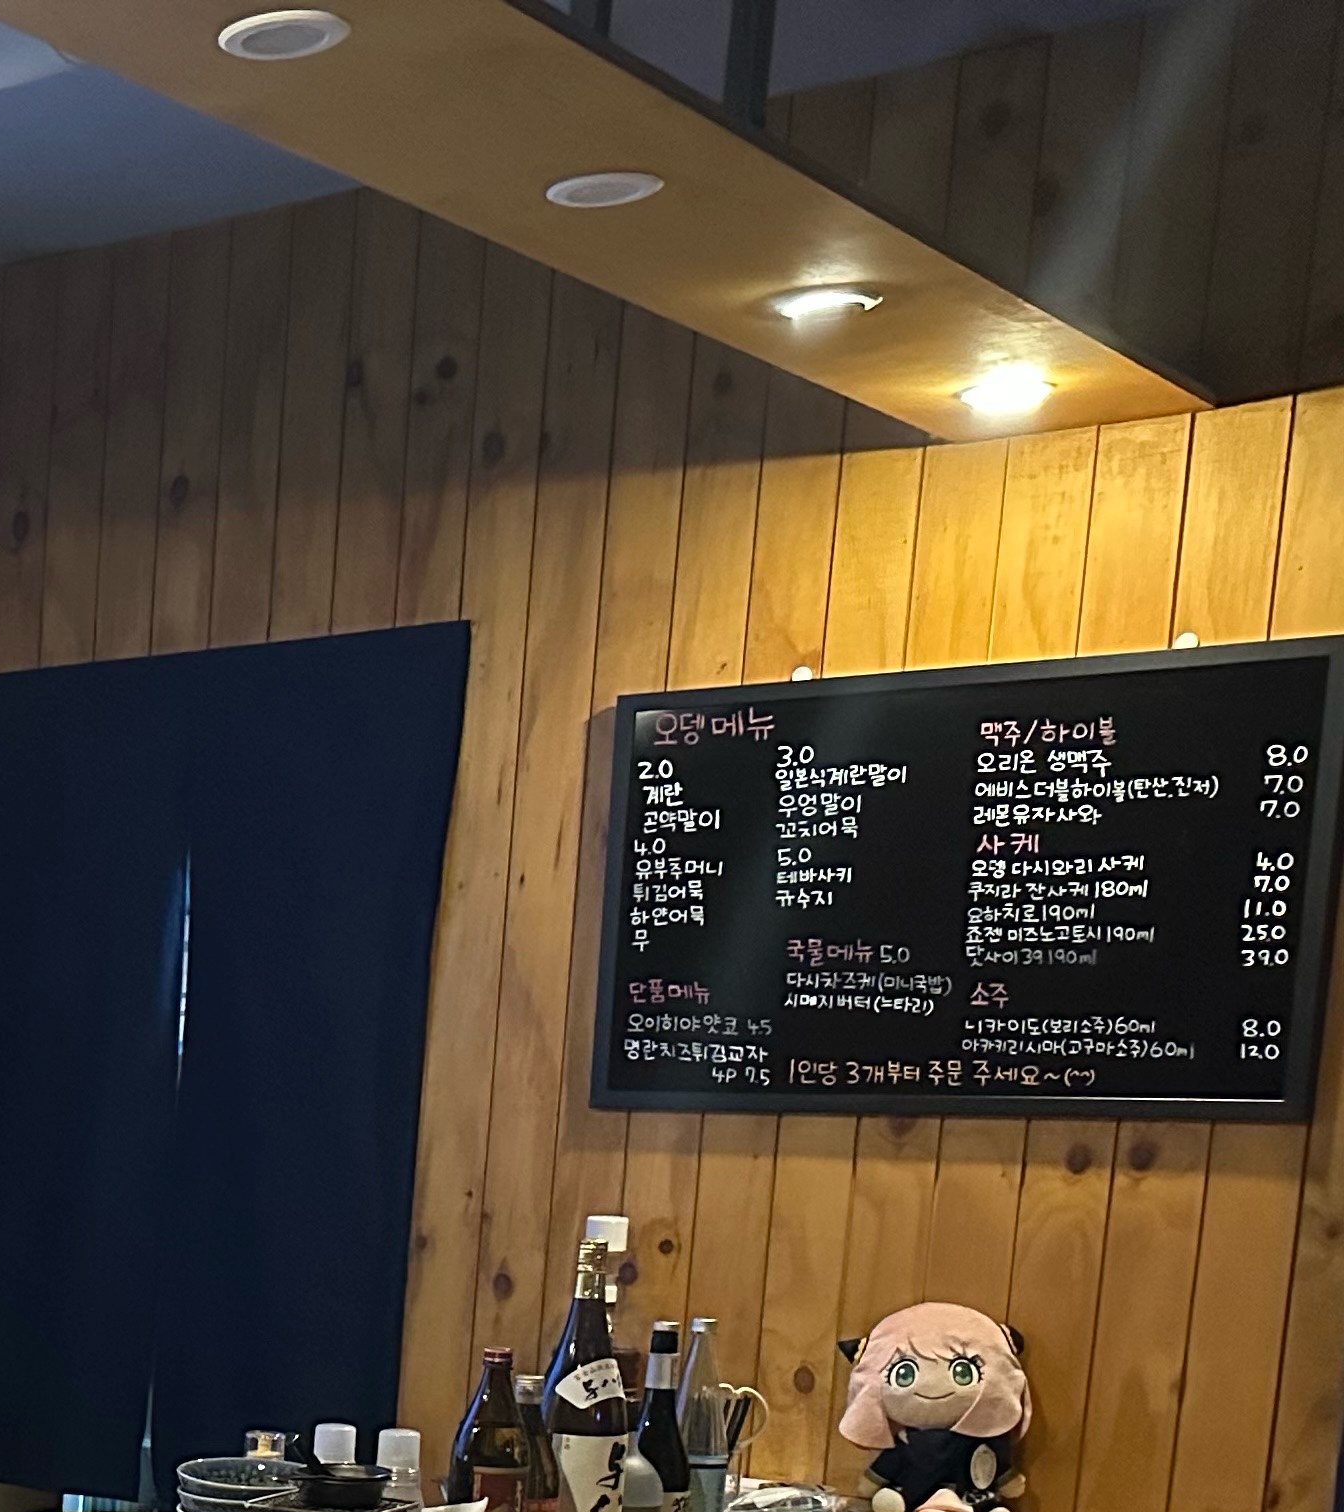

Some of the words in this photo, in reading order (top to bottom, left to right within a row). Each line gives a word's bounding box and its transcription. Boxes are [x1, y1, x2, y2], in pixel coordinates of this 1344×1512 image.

[776, 745, 815, 768] 3.0
[977, 750, 1037, 774] 오리온
[1047, 750, 1112, 778] 생맥주
[1266, 744, 1309, 767] 8.0
[637, 759, 674, 780] 2.0
[642, 782, 684, 807] 계란
[1264, 774, 1304, 795] 7.0
[778, 793, 862, 818] 우엉말이
[1260, 800, 1301, 819] 7.0
[643, 809, 720, 834] 곤약말이
[775, 816, 859, 839] 꼬치어묵
[633, 838, 666, 856] 4.0
[976, 833, 1040, 855] 사케
[777, 848, 812, 866] 5.0
[972, 860, 1006, 878] 오뎅
[1012, 859, 1092, 876] 다시와리
[1098, 855, 1145, 872] 사케
[1256, 852, 1294, 872] 4.0
[776, 867, 852, 884] 테바사키
[1254, 875, 1290, 892] 7.0
[633, 880, 704, 903] 튀김어묵
[967, 882, 1022, 902] 쿠지라
[1094, 880, 1149, 898] 180ml
[630, 905, 704, 926] 하얀어묵
[1243, 899, 1287, 918] 11.0
[631, 929, 650, 952] 무
[879, 944, 910, 964] 5.0
[1240, 950, 1289, 967] 39.0
[970, 982, 1009, 1009] 소주
[1241, 1019, 1282, 1038] 8.0
[1240, 1044, 1280, 1060] 12.0
[745, 1067, 771, 1086] 7.5
[927, 1059, 963, 1087] 주문
